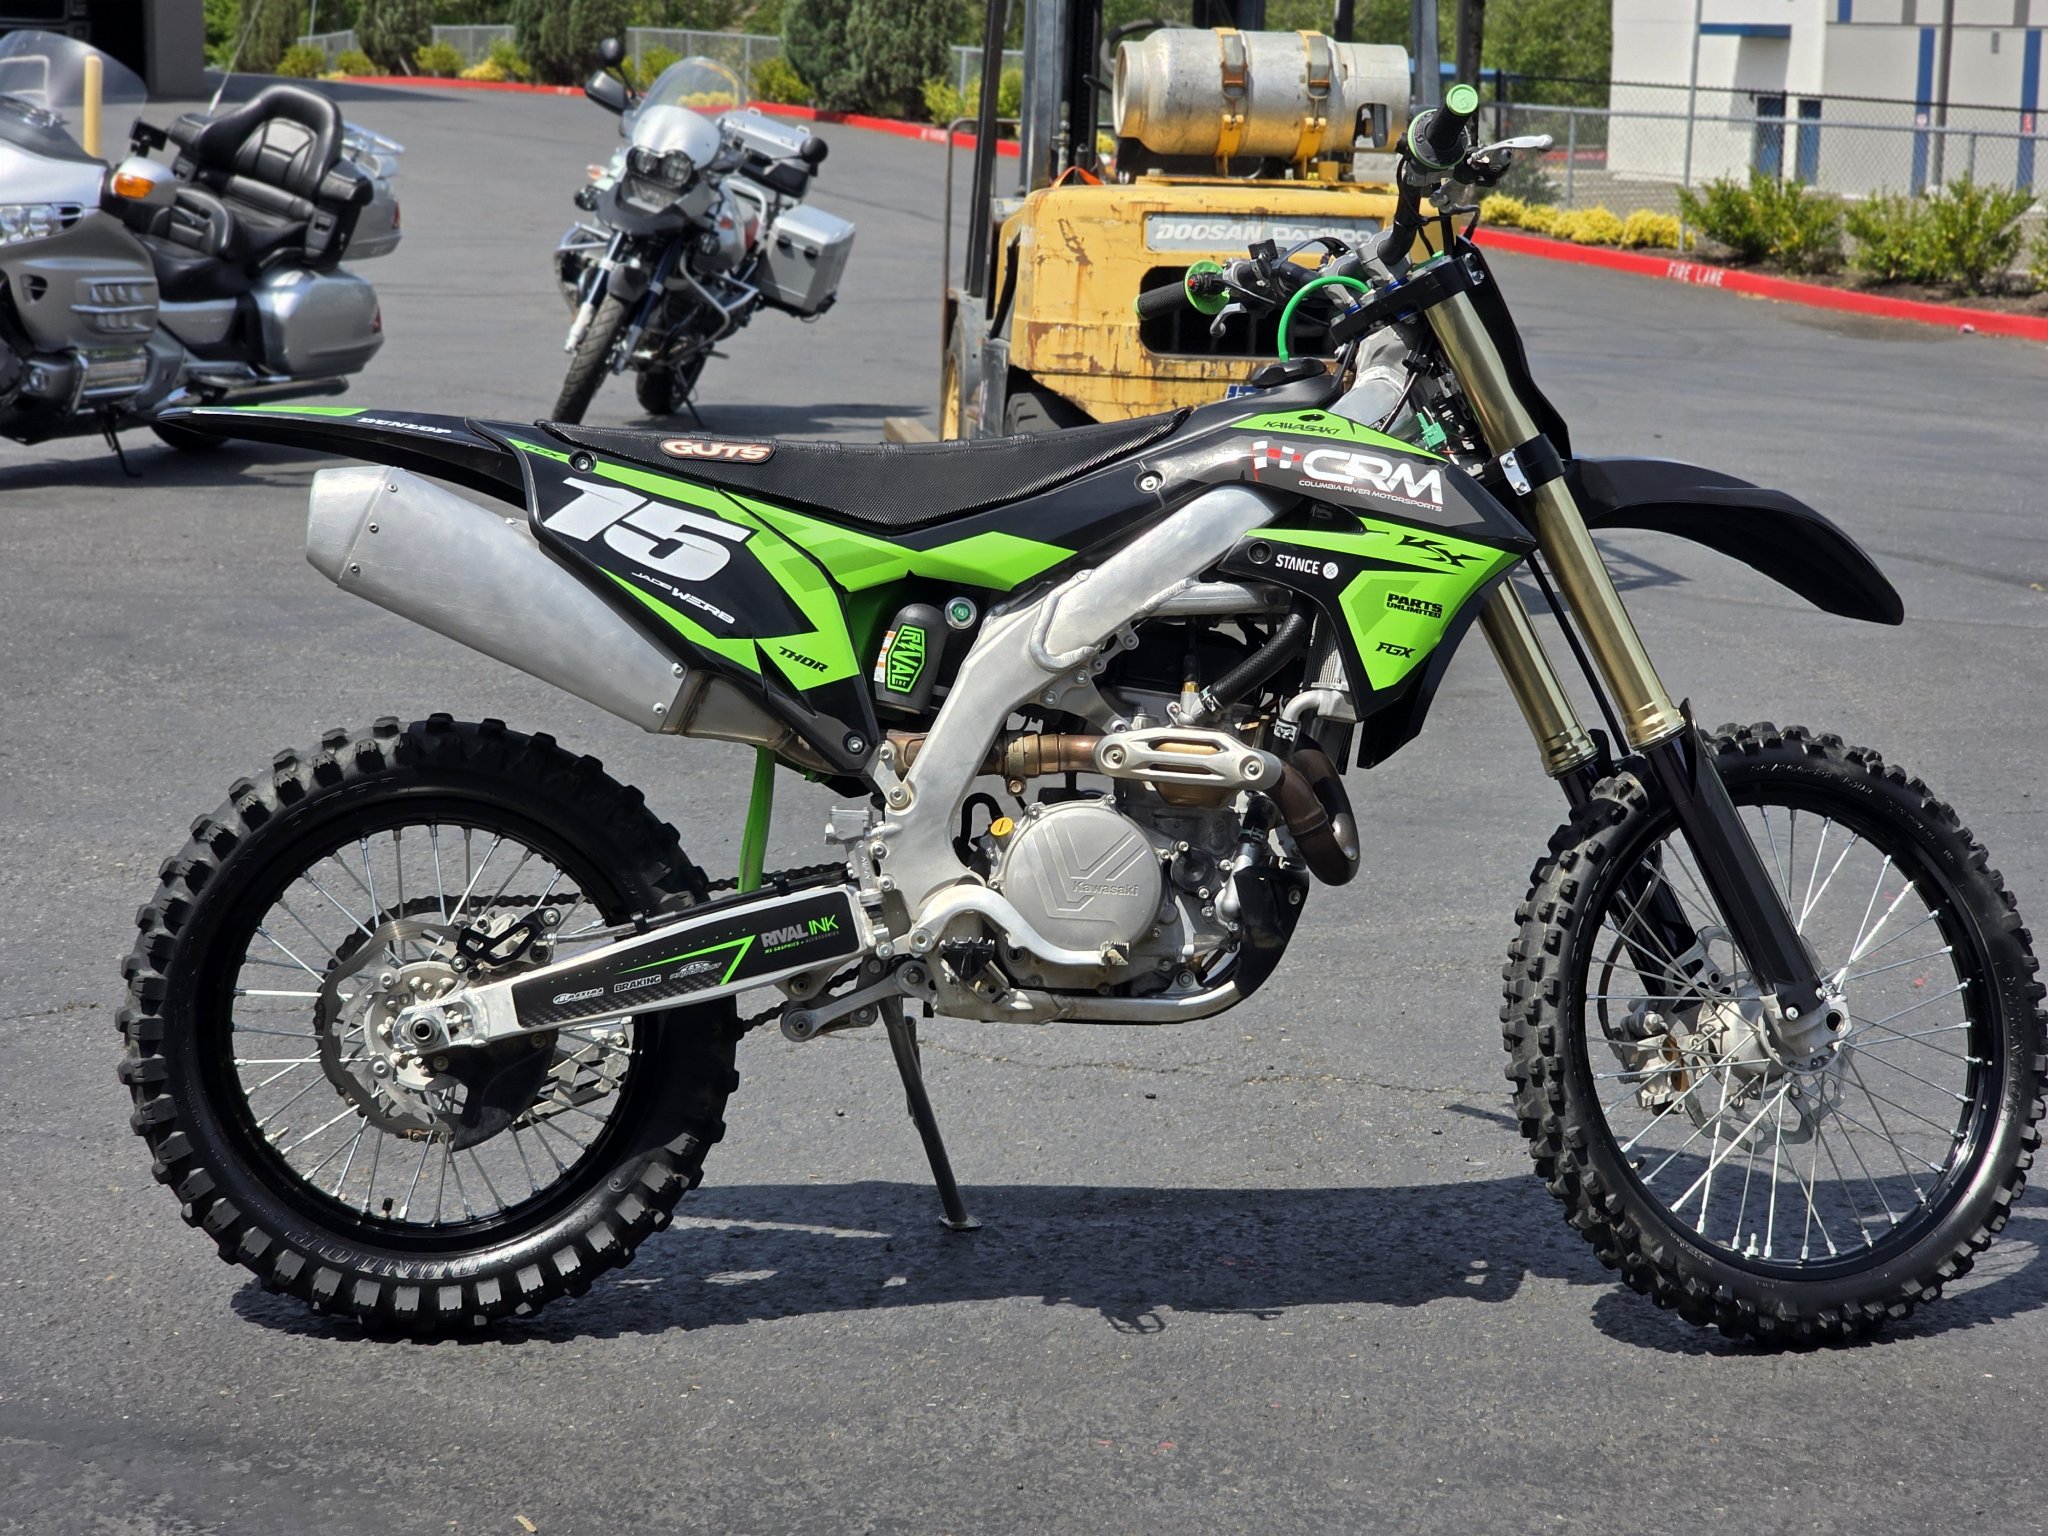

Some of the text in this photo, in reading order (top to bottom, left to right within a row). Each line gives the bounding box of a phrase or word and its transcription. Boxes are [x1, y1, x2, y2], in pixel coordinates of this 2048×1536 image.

[1156, 223, 1264, 240] DOOSAN
[1667, 261, 1724, 287] FIRE LANE
[357, 417, 452, 434] DUNLOP
[1264, 421, 1341, 435] KAWASAKI
[663, 440, 771, 460] GUTS
[1302, 449, 1444, 505] CRM
[1298, 480, 1443, 512] COLUMBIA RIVER MOTORSPORTS
[543, 477, 751, 581] 15
[1275, 554, 1320, 575] STANCE
[631, 572, 736, 625] JADE WERB
[1387, 593, 1443, 613] PARTS
[1386, 602, 1443, 619] UNLIMITED
[779, 646, 829, 673] THOR
[891, 631, 924, 684] RIVAL
[1375, 641, 1417, 659] FGX
[1073, 880, 1140, 897] Kawasaki
[761, 914, 839, 947] RIVAL INK
[614, 975, 661, 992] BRAKING
[284, 1231, 481, 1280] DUNLOP
